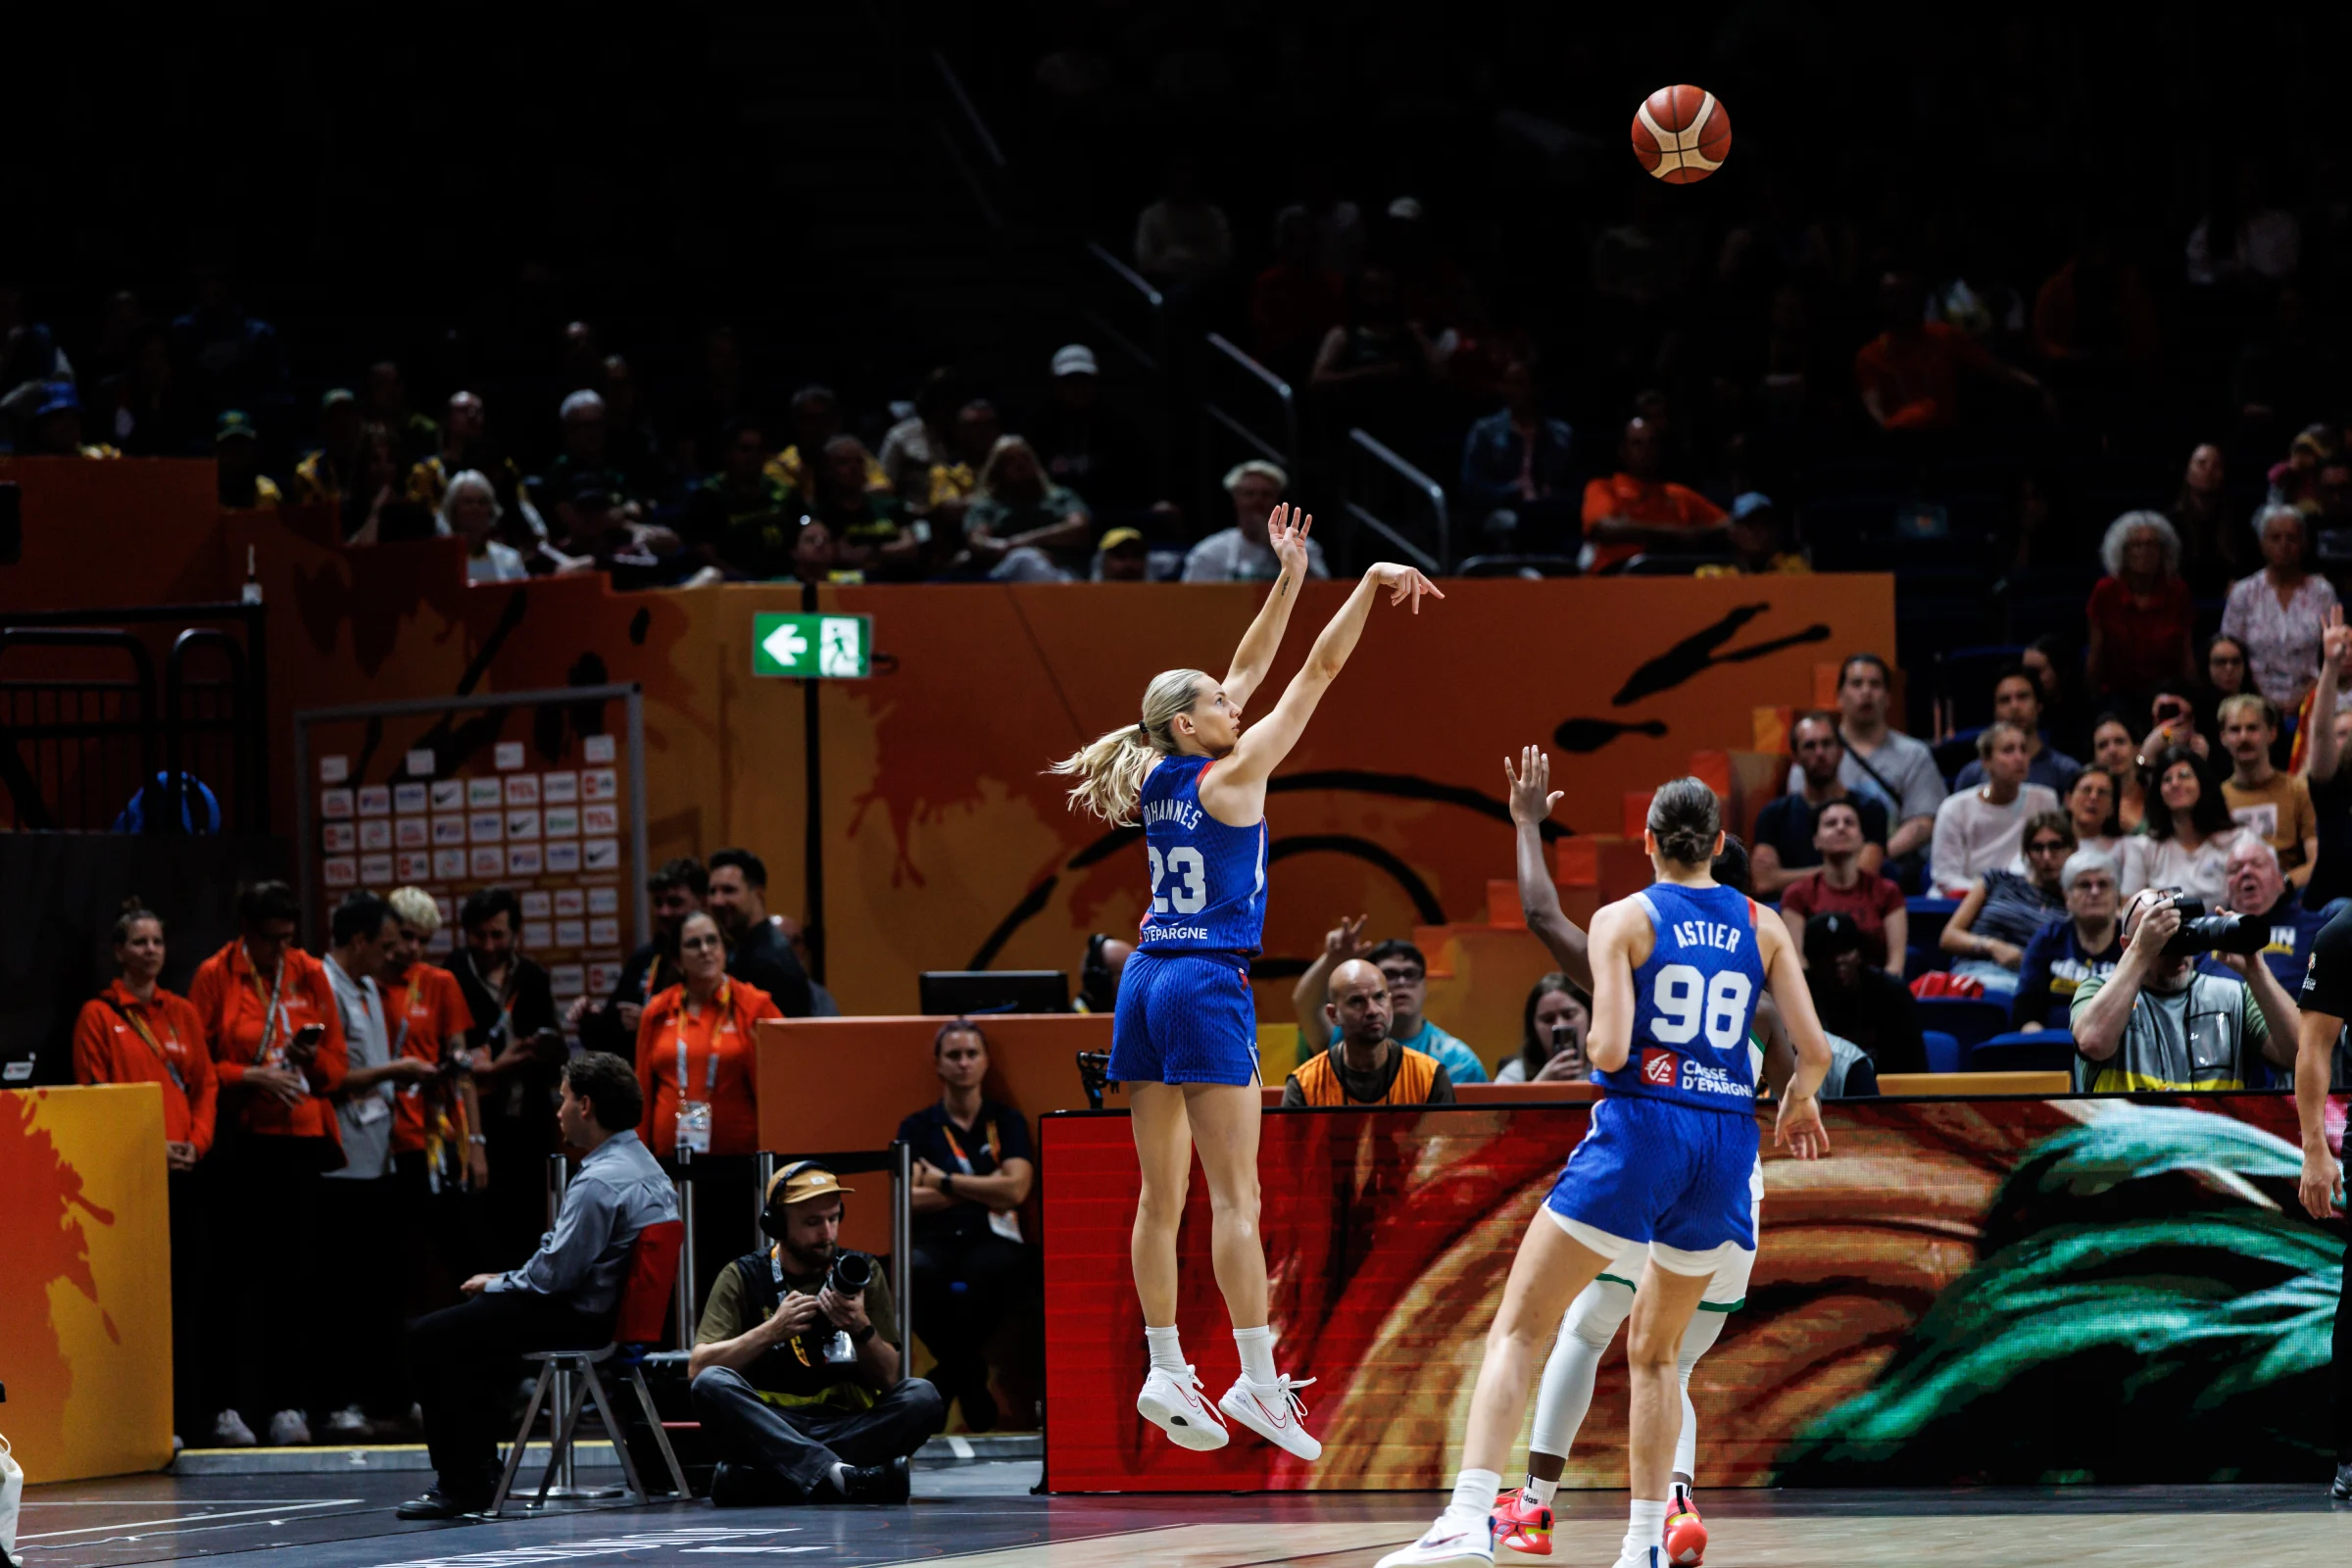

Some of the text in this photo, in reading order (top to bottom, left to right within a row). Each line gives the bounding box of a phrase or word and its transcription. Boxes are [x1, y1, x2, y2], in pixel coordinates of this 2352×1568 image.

[1144, 799, 1202, 830] OHANNÈS
[1148, 846, 1206, 914] 23
[1673, 920, 1741, 953] ASTIER
[1650, 963, 1752, 1050] 98
[1523, 1494, 1539, 1504] das
